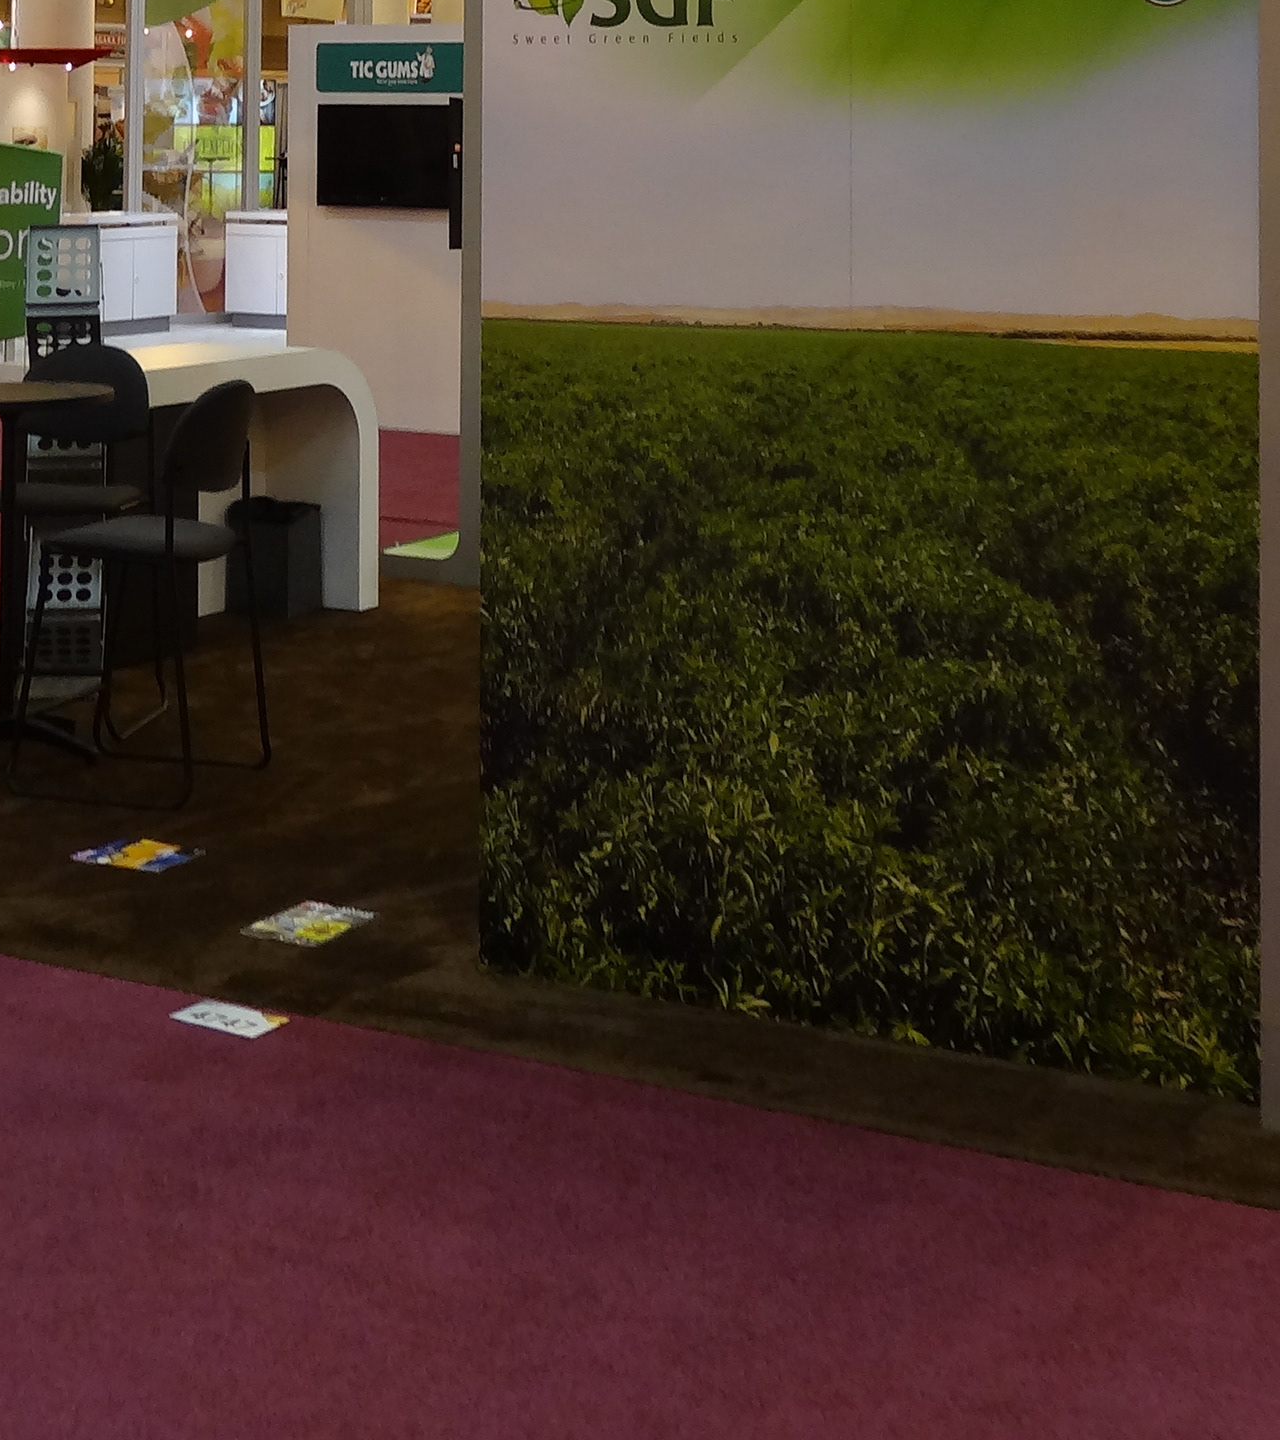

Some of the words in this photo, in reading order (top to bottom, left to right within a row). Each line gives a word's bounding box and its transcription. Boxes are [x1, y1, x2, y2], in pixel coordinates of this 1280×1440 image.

[512, 33, 572, 46] Sweet
[588, 32, 650, 45] Green
[667, 31, 739, 45] Fields
[349, 59, 374, 79] TIC
[375, 59, 419, 79] GUMS
